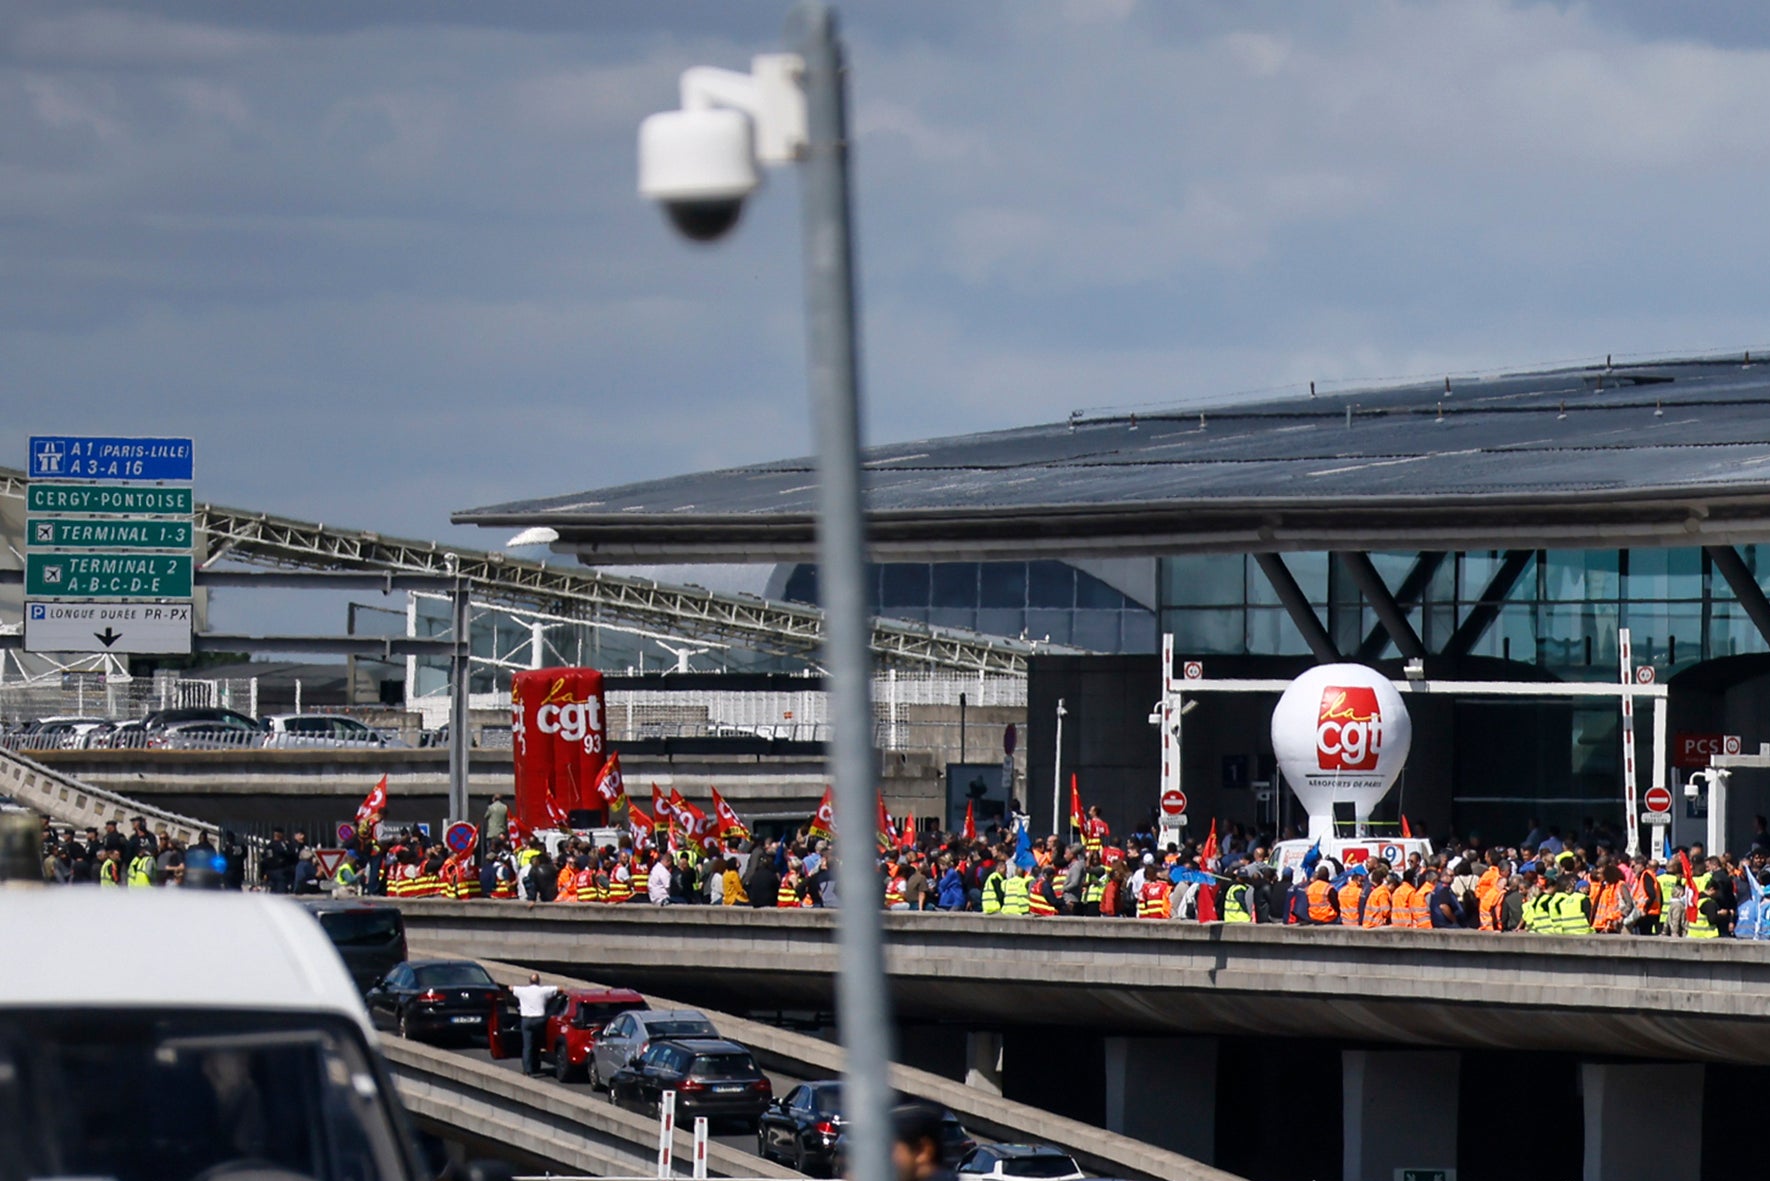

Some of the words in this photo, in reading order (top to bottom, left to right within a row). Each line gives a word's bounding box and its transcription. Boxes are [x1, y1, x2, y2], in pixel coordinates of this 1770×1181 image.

[100, 445, 189, 459] (PARIS-LILLE)
[35, 491, 185, 508] CERGY-PONTOISE
[62, 526, 148, 541] TERMINAL
[160, 528, 186, 542] 1-3
[69, 558, 156, 575] TERMINAL
[167, 560, 177, 575] 2
[67, 577, 160, 592] A-B-C-D-E
[50, 608, 95, 619] LONGUE
[100, 608, 137, 620] DURÉE
[145, 608, 188, 620] PR-PX
[540, 678, 588, 705] la
[1320, 691, 1381, 721] la
[537, 695, 601, 741] cgt
[584, 734, 601, 754] 93
[1317, 712, 1382, 765] cgt
[1685, 739, 1719, 754] PCS
